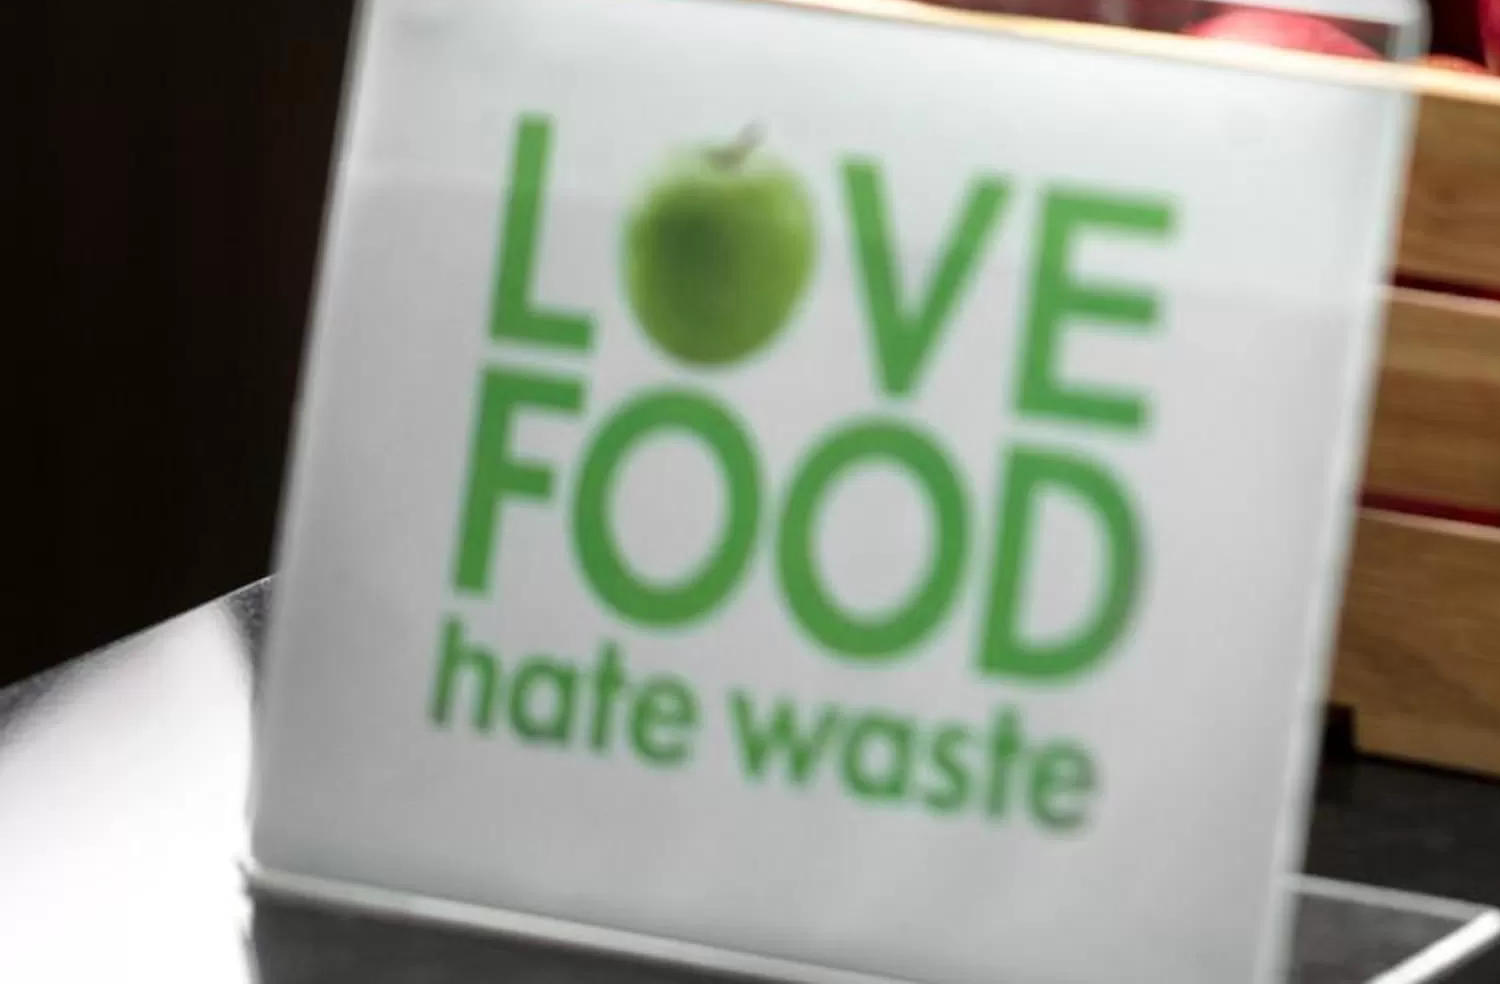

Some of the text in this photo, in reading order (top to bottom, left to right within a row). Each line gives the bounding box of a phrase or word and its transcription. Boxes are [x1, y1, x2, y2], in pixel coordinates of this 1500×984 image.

[486, 113, 1182, 440] LOVE
[450, 362, 1148, 688] FOOD
[427, 617, 1102, 832] hate waste
